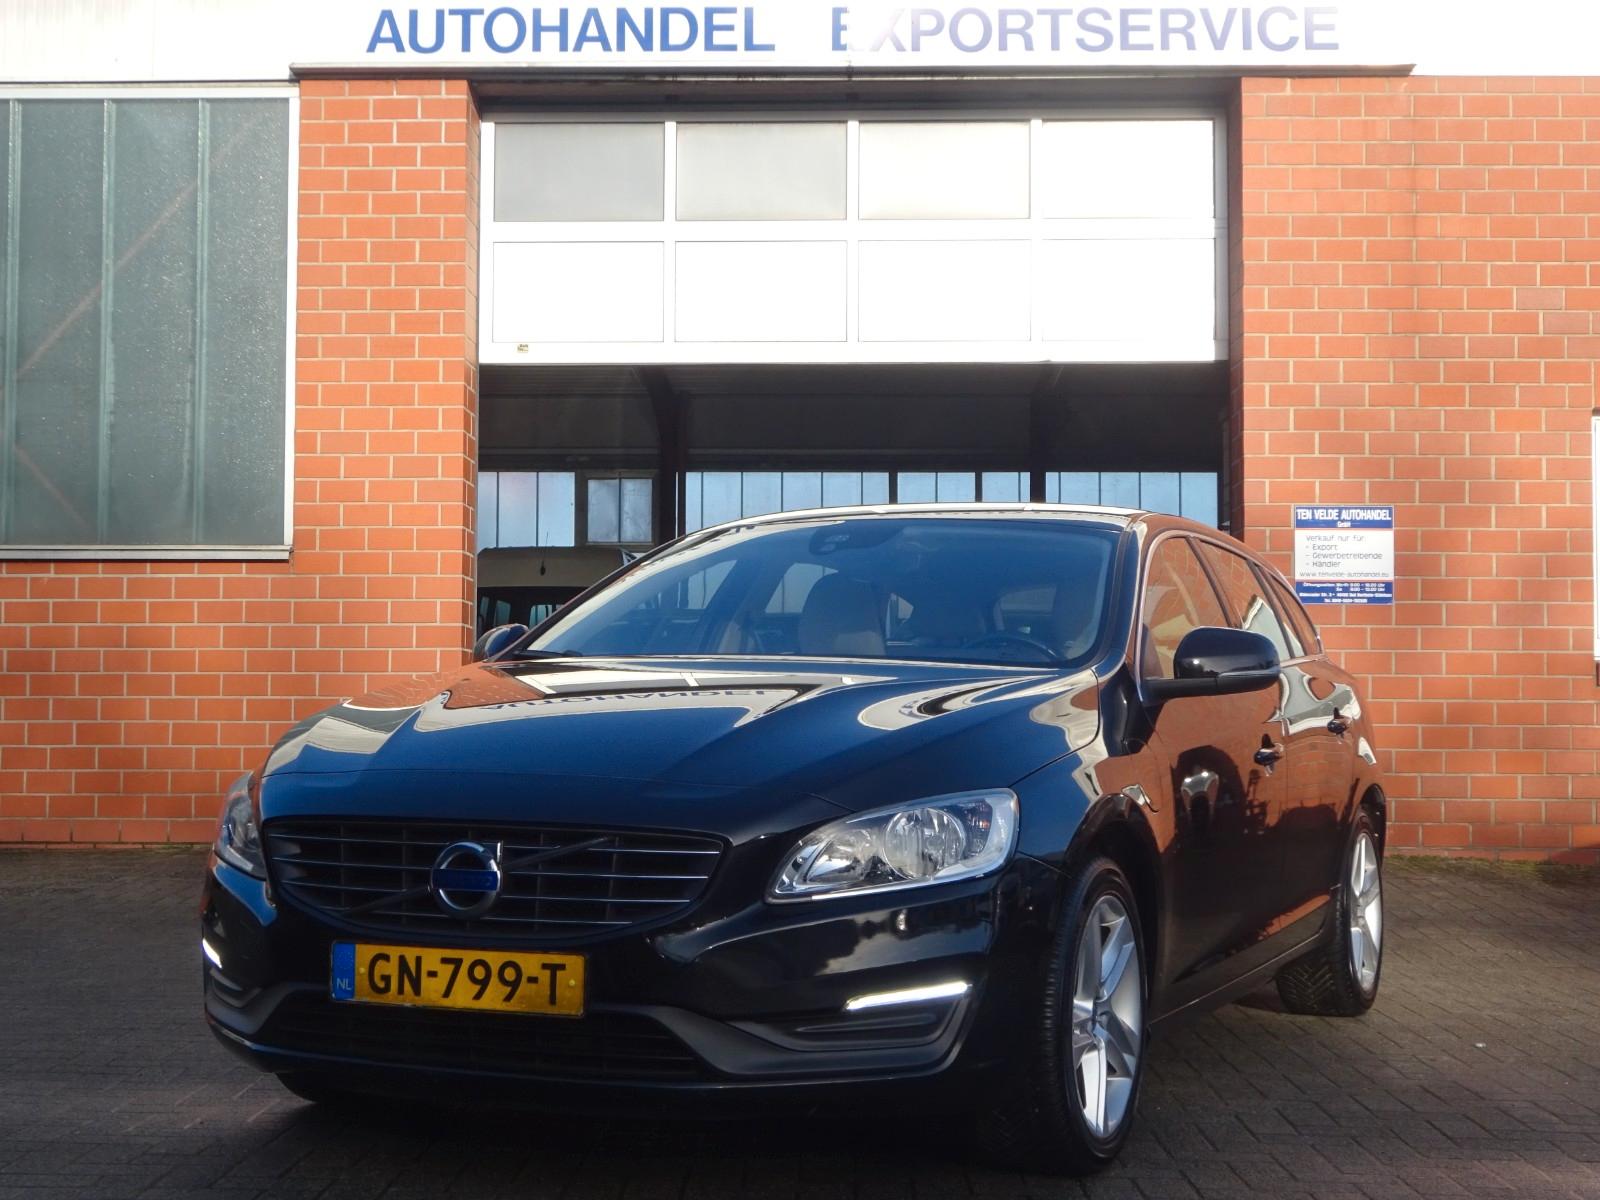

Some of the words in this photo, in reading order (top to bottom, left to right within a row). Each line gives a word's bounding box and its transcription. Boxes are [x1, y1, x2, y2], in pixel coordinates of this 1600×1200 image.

[366, 7, 776, 54] AUTOHANDEL
[1297, 509, 1312, 520] TEN
[1314, 509, 1339, 520] VELDE
[1341, 509, 1391, 520] AUTOHANDEL
[1312, 543, 1338, 551] Export
[1312, 552, 1383, 560] Gewerbetreibende
[336, 978, 353, 991] NL
[367, 952, 567, 1006] GN-799-T
